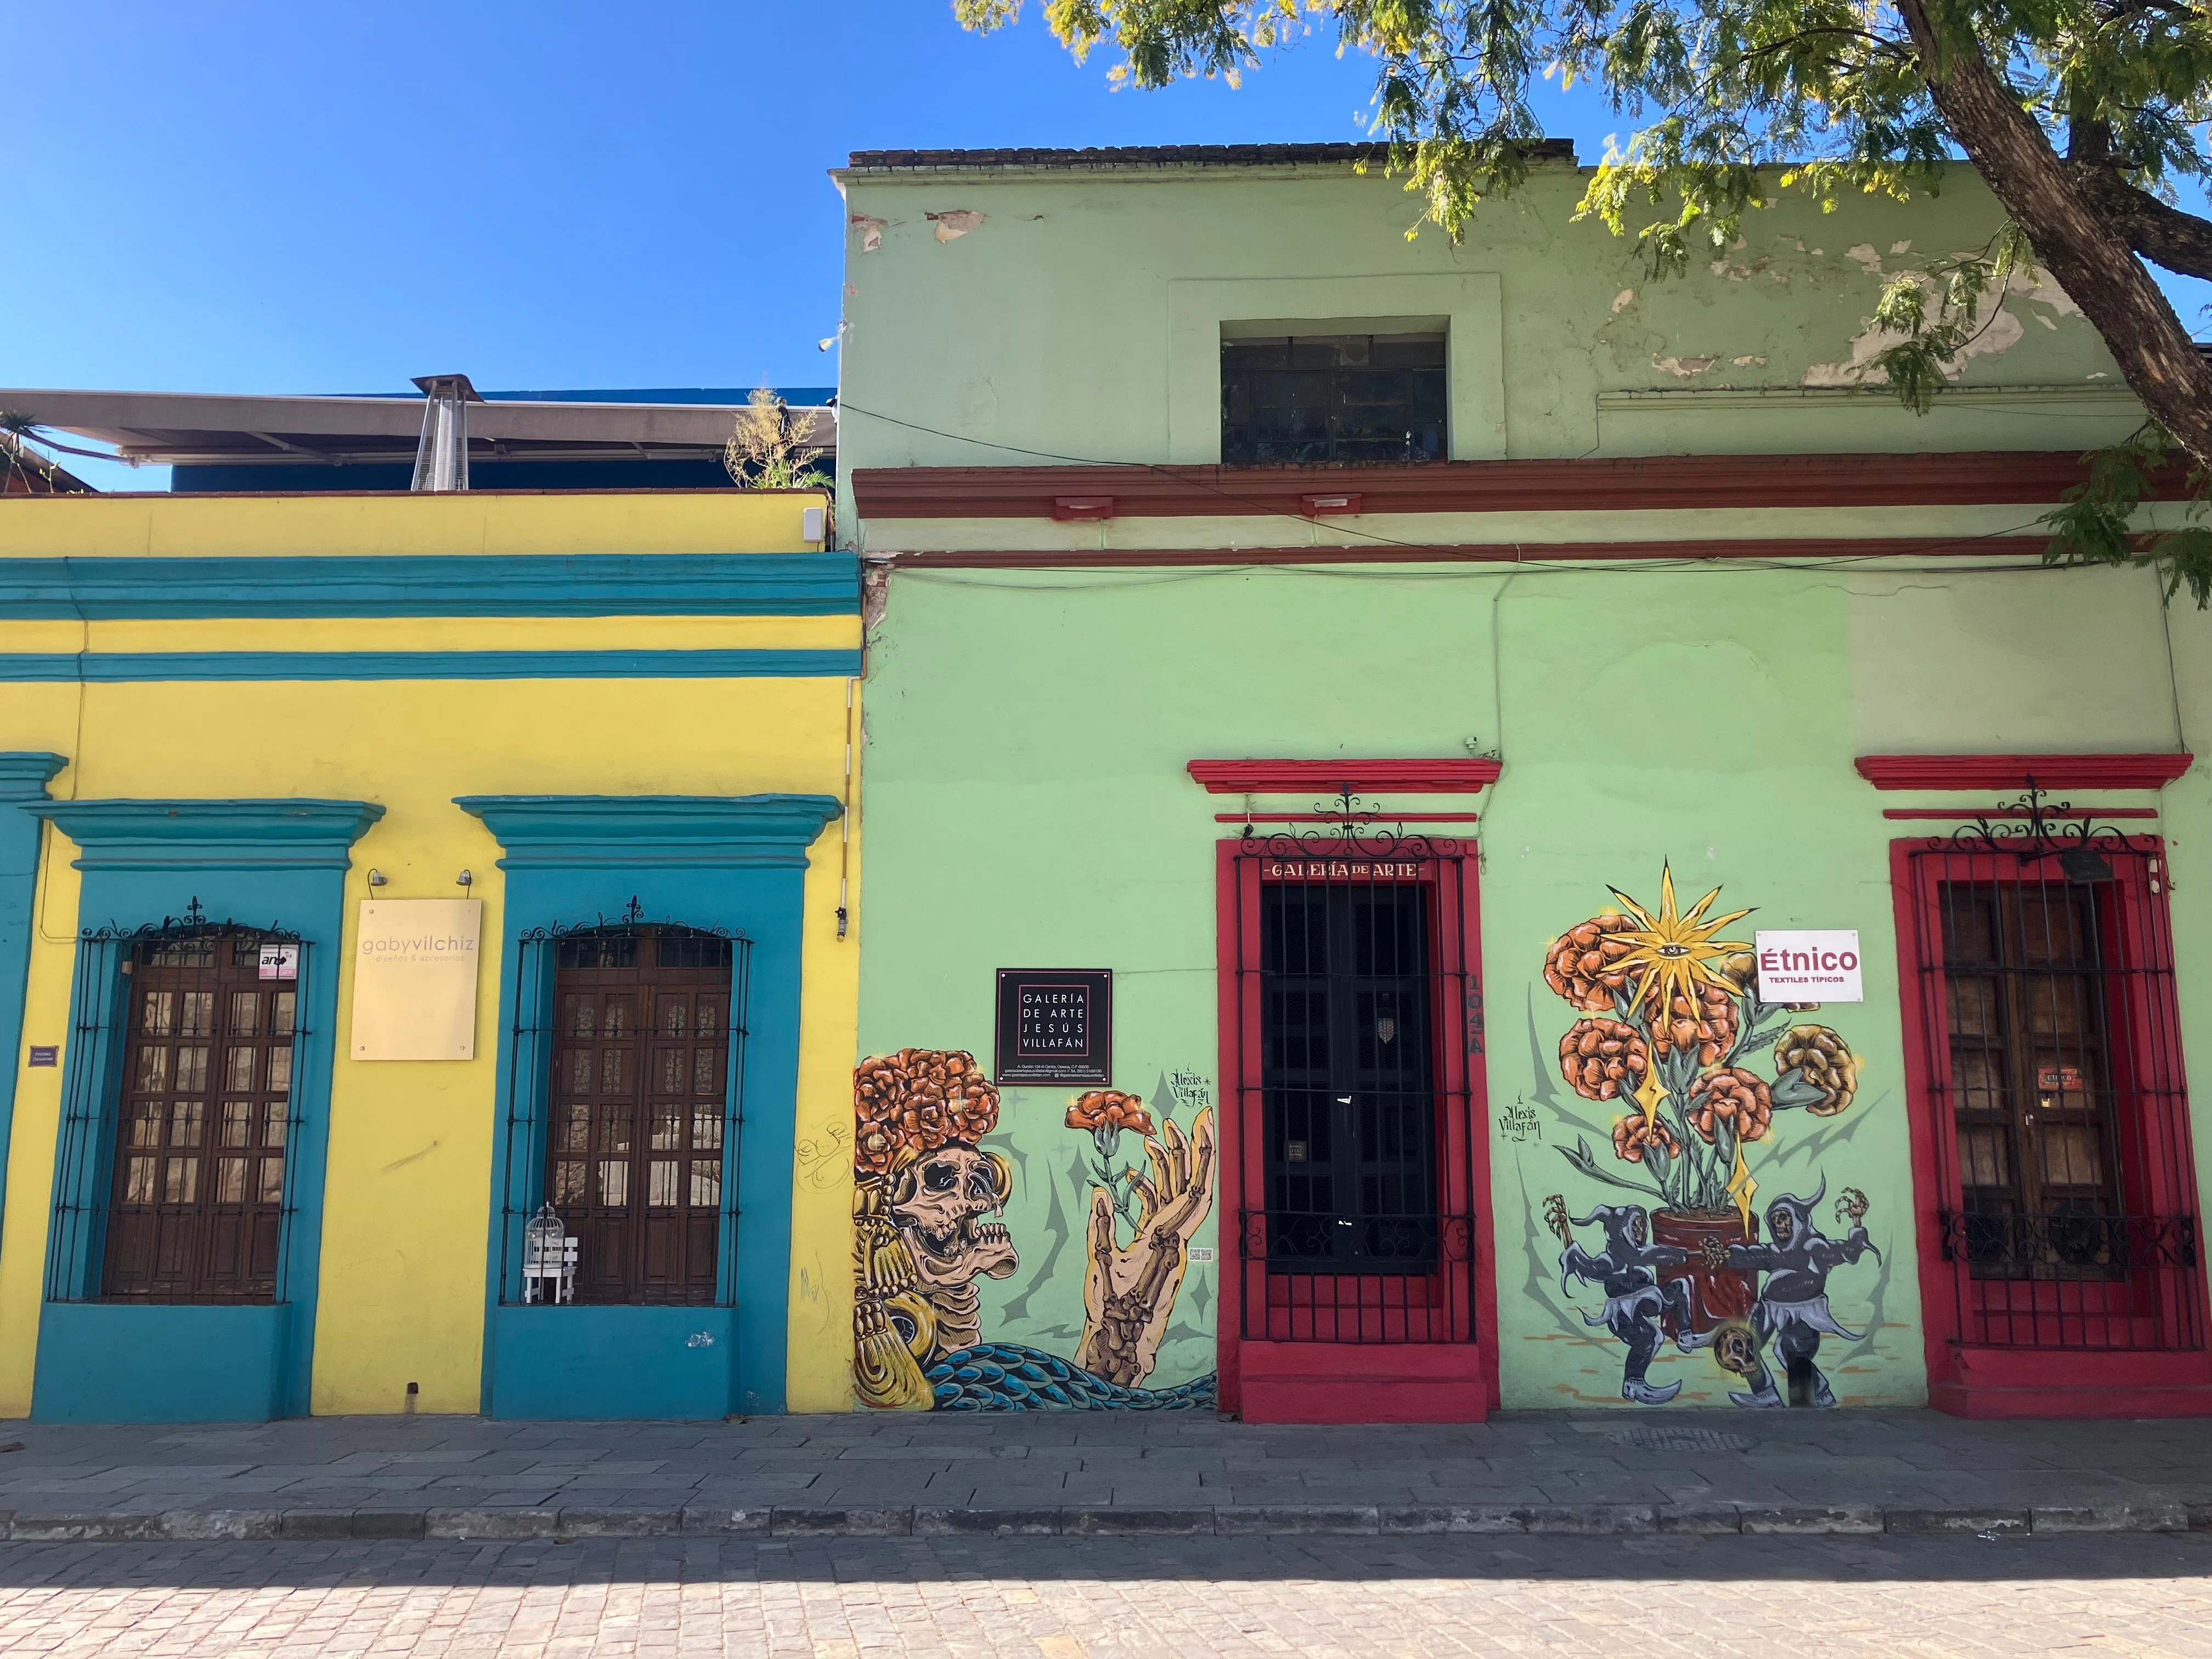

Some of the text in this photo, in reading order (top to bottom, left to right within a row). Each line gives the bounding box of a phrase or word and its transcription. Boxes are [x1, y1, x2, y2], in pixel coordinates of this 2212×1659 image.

[1352, 865, 1369, 873] DE
[1373, 864, 1417, 876] ARTE
[1760, 947, 1858, 971] Étnico
[1023, 994, 1084, 1003] GALERÍA
[1024, 1009, 1084, 1018] DE ARTE
[1023, 1023, 1083, 1032] JESÚS
[1023, 1037, 1083, 1048] VILLAFÁN
